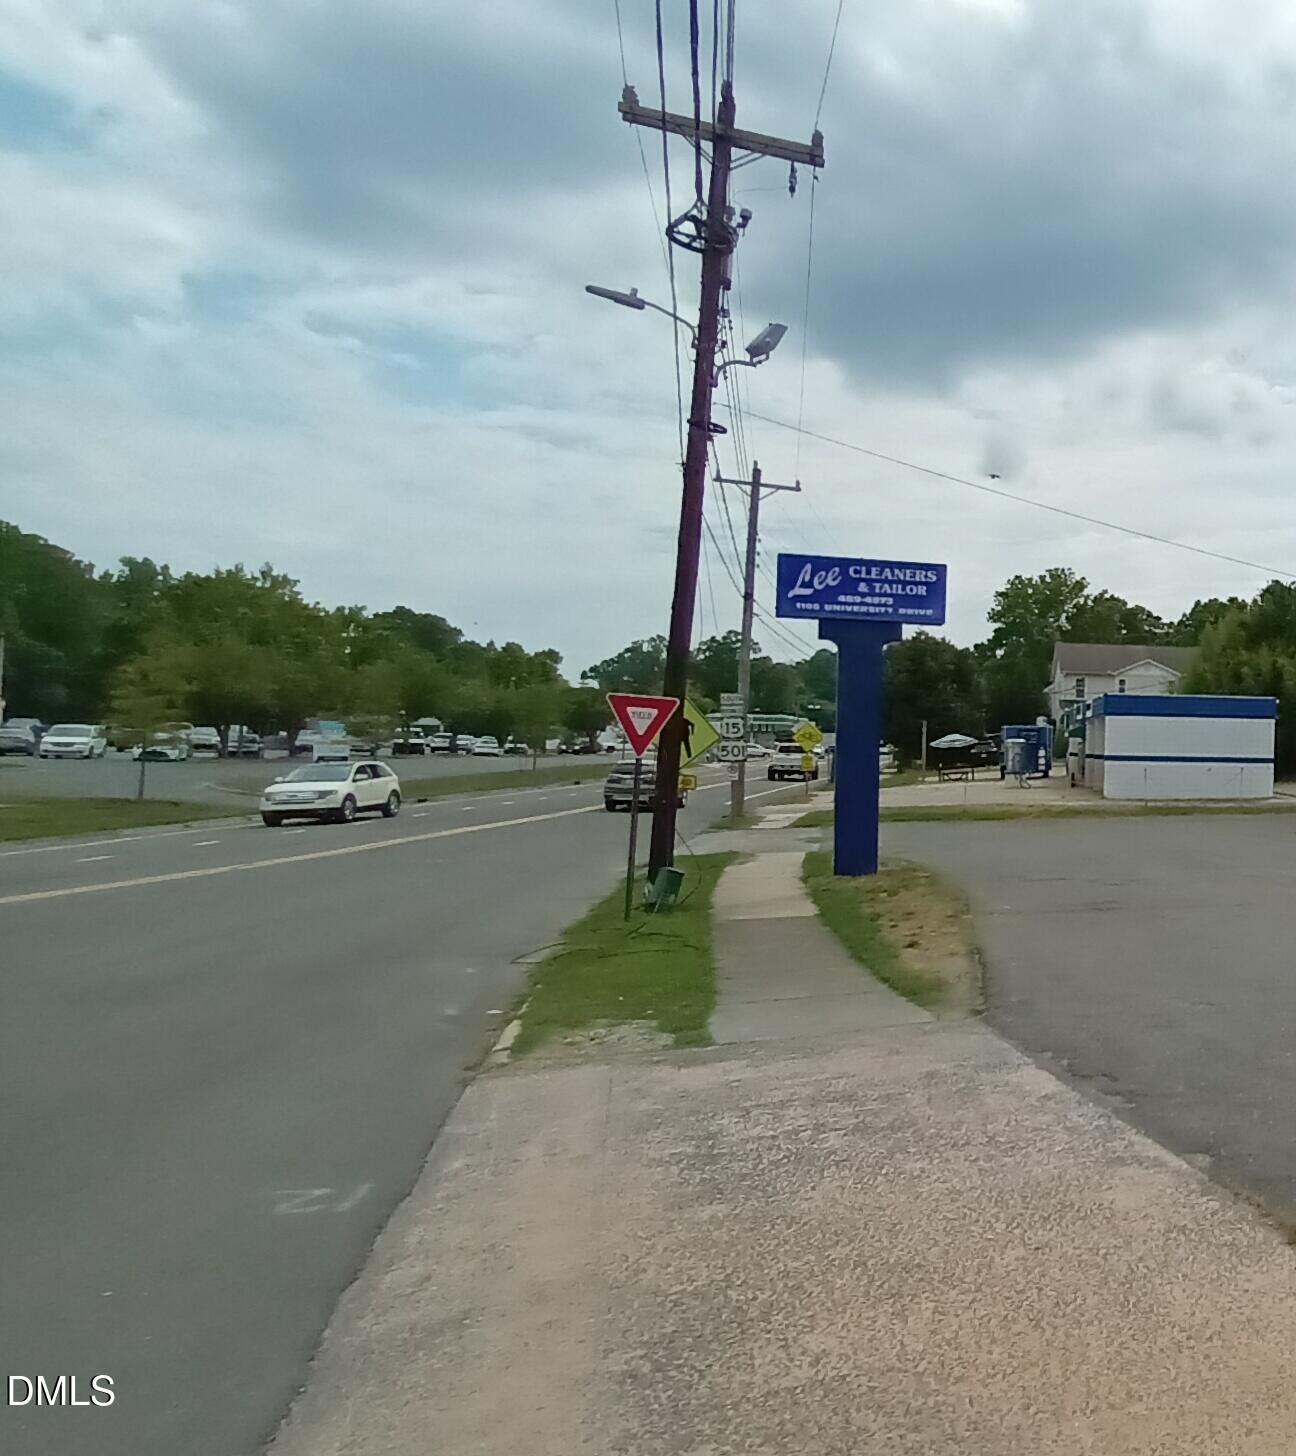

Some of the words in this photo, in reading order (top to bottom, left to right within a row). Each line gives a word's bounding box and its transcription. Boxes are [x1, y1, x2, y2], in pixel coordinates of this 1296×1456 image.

[848, 565, 937, 582] CLEANERS
[788, 563, 842, 598] Lee
[858, 582, 869, 593] &
[873, 583, 927, 596] TAILOR
[824, 604, 893, 613] UNIVERSITY
[898, 607, 933, 615] DRIVE
[725, 722, 741, 734] 15
[721, 745, 745, 758] 501
